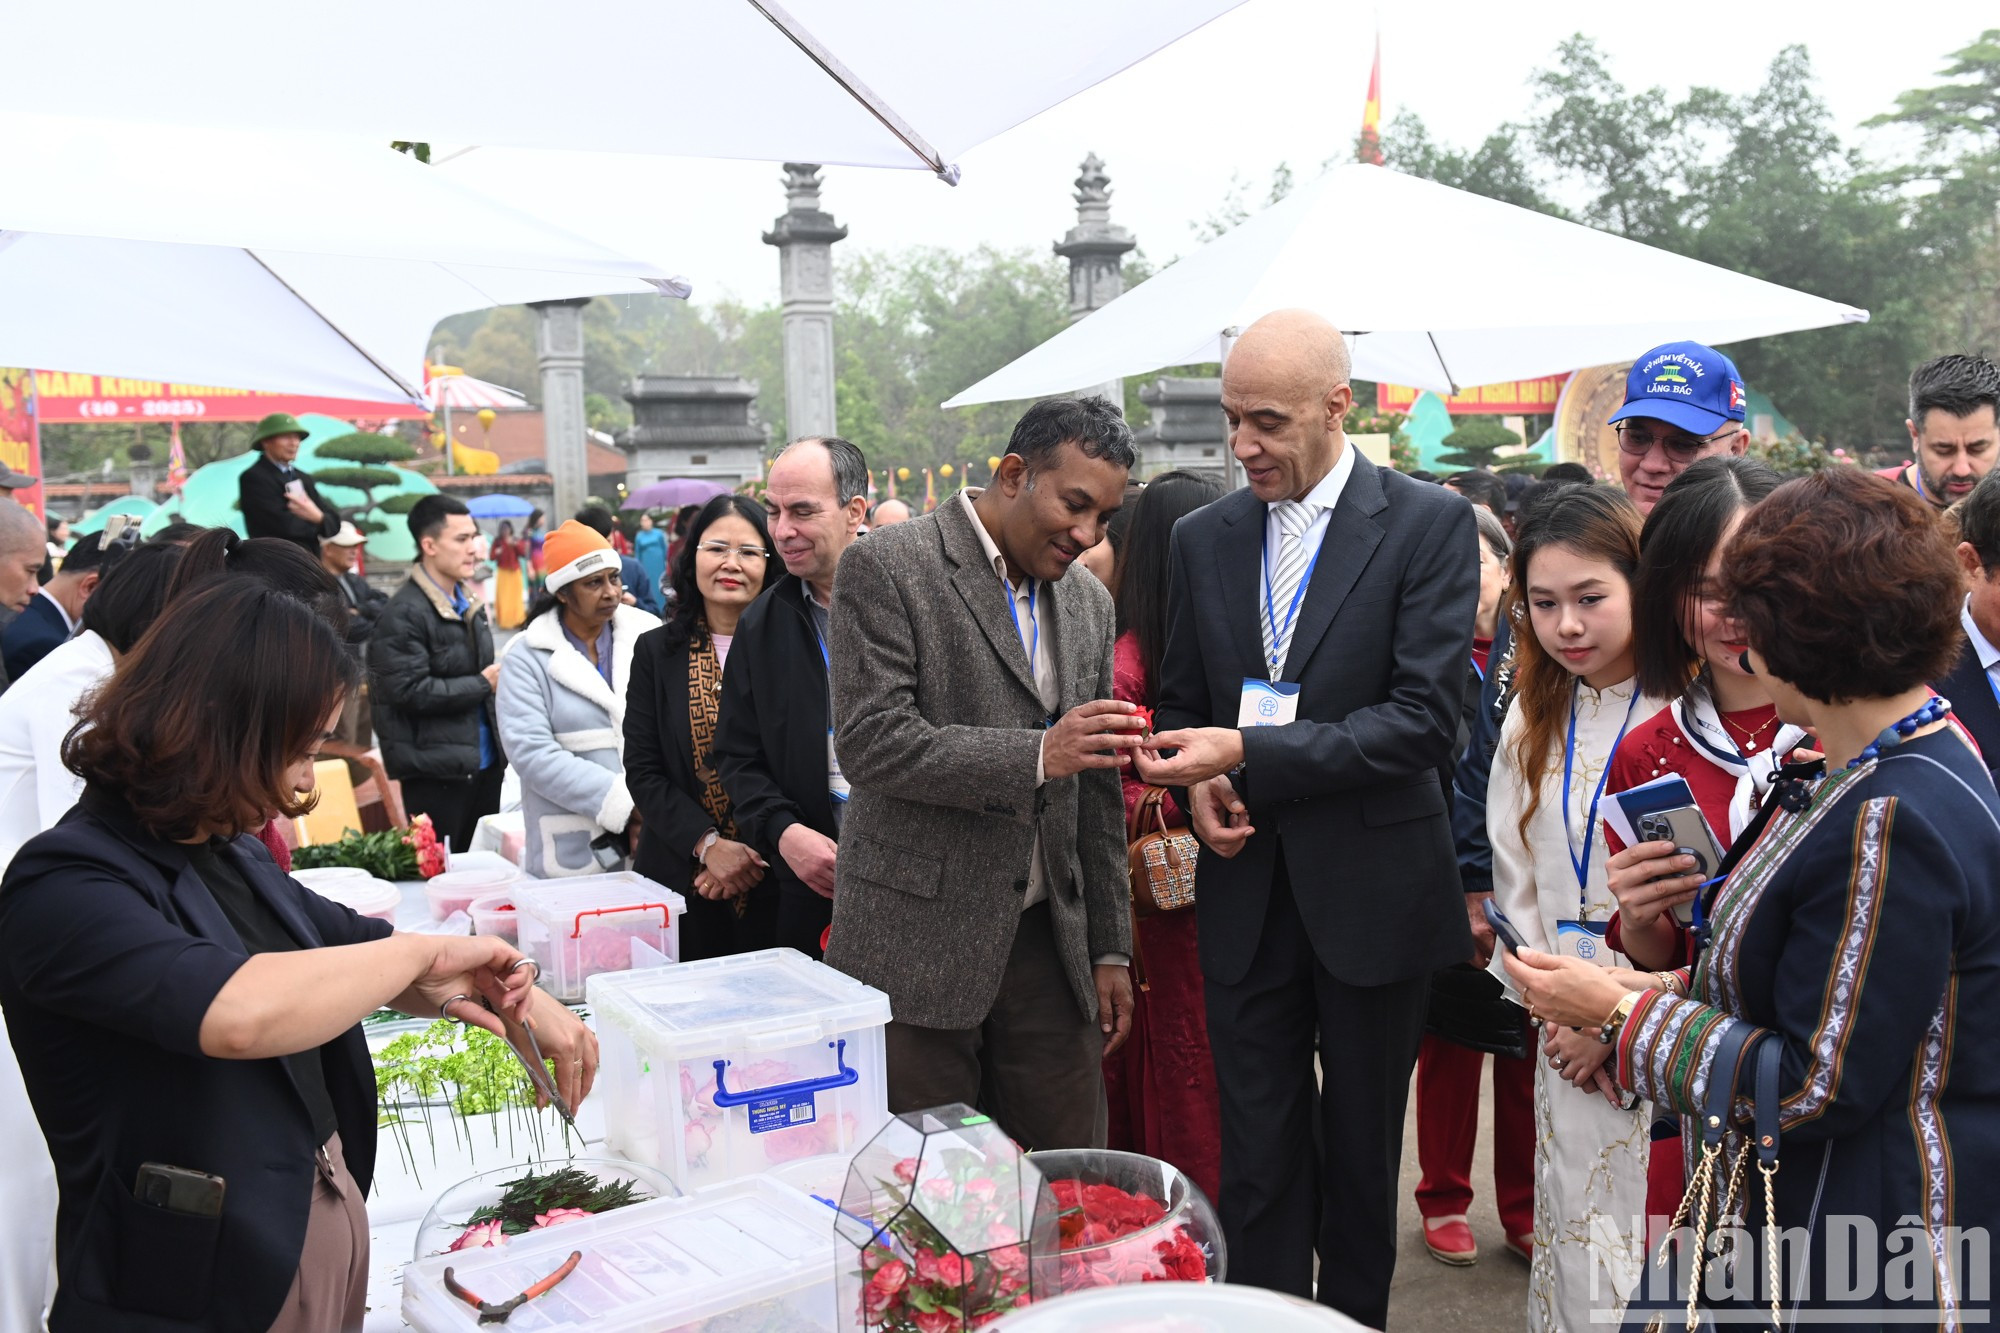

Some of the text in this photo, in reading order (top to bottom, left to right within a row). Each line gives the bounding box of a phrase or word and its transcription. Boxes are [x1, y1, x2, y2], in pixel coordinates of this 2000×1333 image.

[1647, 382, 1693, 396] LĂNG BÁC
[142, 399, 206, 418] 2025)
